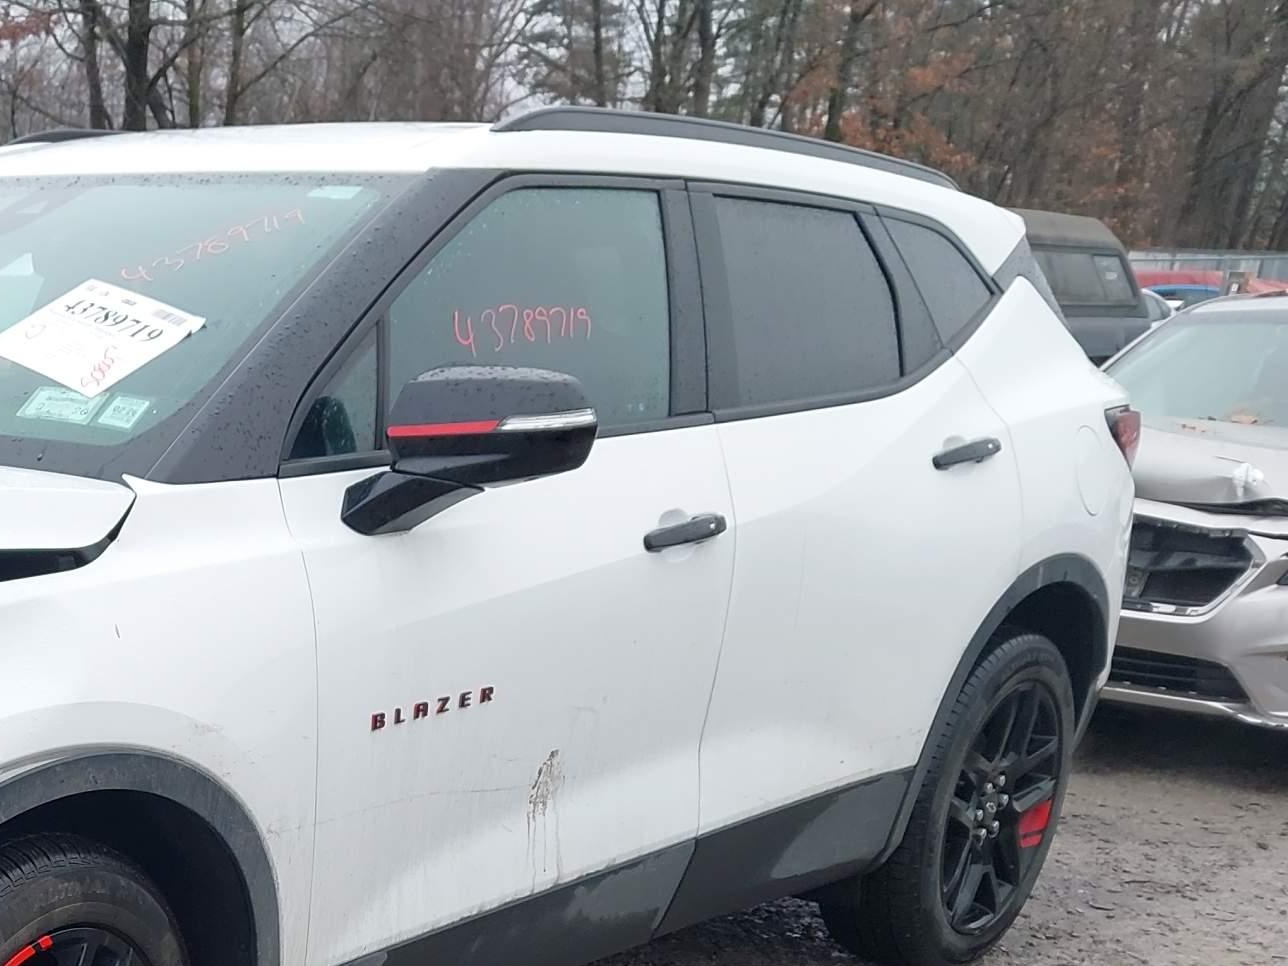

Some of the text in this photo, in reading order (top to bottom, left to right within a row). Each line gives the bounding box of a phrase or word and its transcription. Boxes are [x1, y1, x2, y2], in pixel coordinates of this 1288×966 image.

[64, 299, 164, 342] 43789719
[453, 304, 591, 357] 43789719
[371, 686, 494, 731] BLAZER
